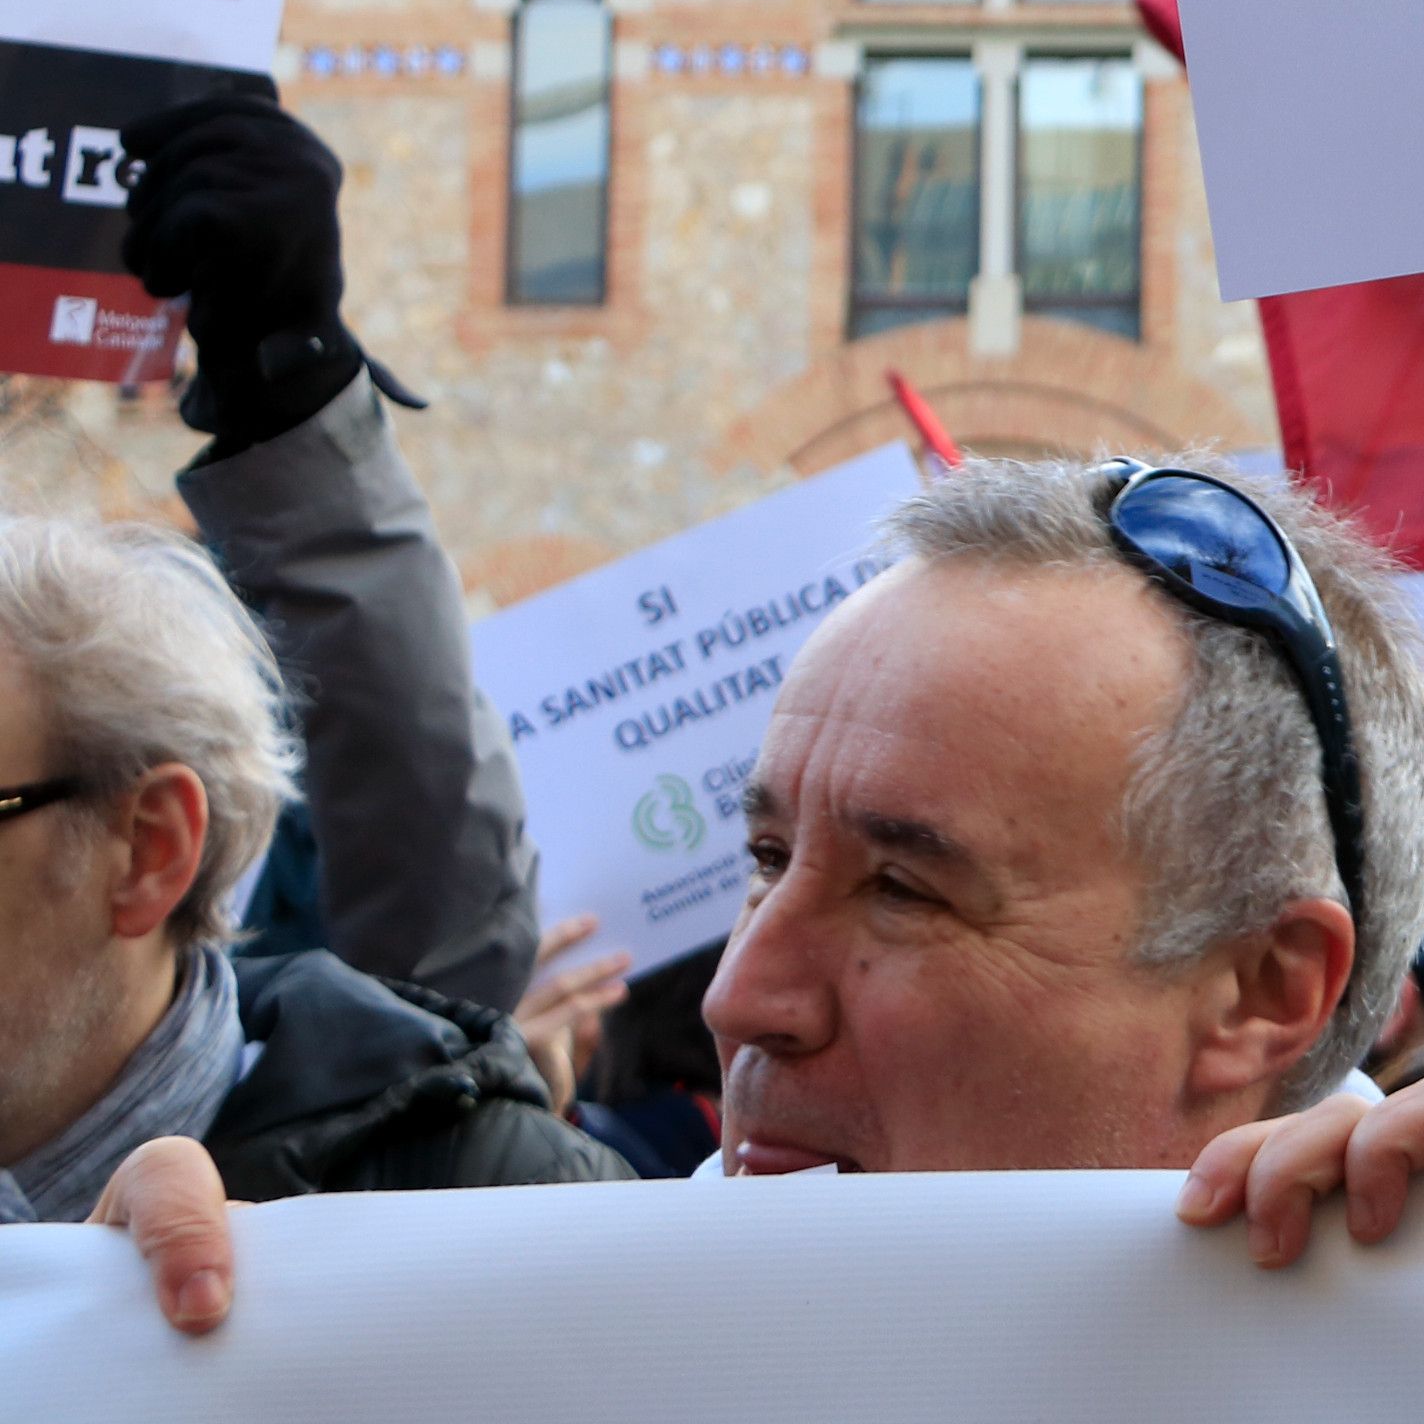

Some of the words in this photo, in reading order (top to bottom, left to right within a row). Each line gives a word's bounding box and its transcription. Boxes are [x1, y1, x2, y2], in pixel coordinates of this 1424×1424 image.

[541, 640, 688, 726] SANITAT
[696, 574, 849, 659] PÚBLICA
[638, 585, 678, 623] SI
[614, 653, 785, 752] QUALITAT
